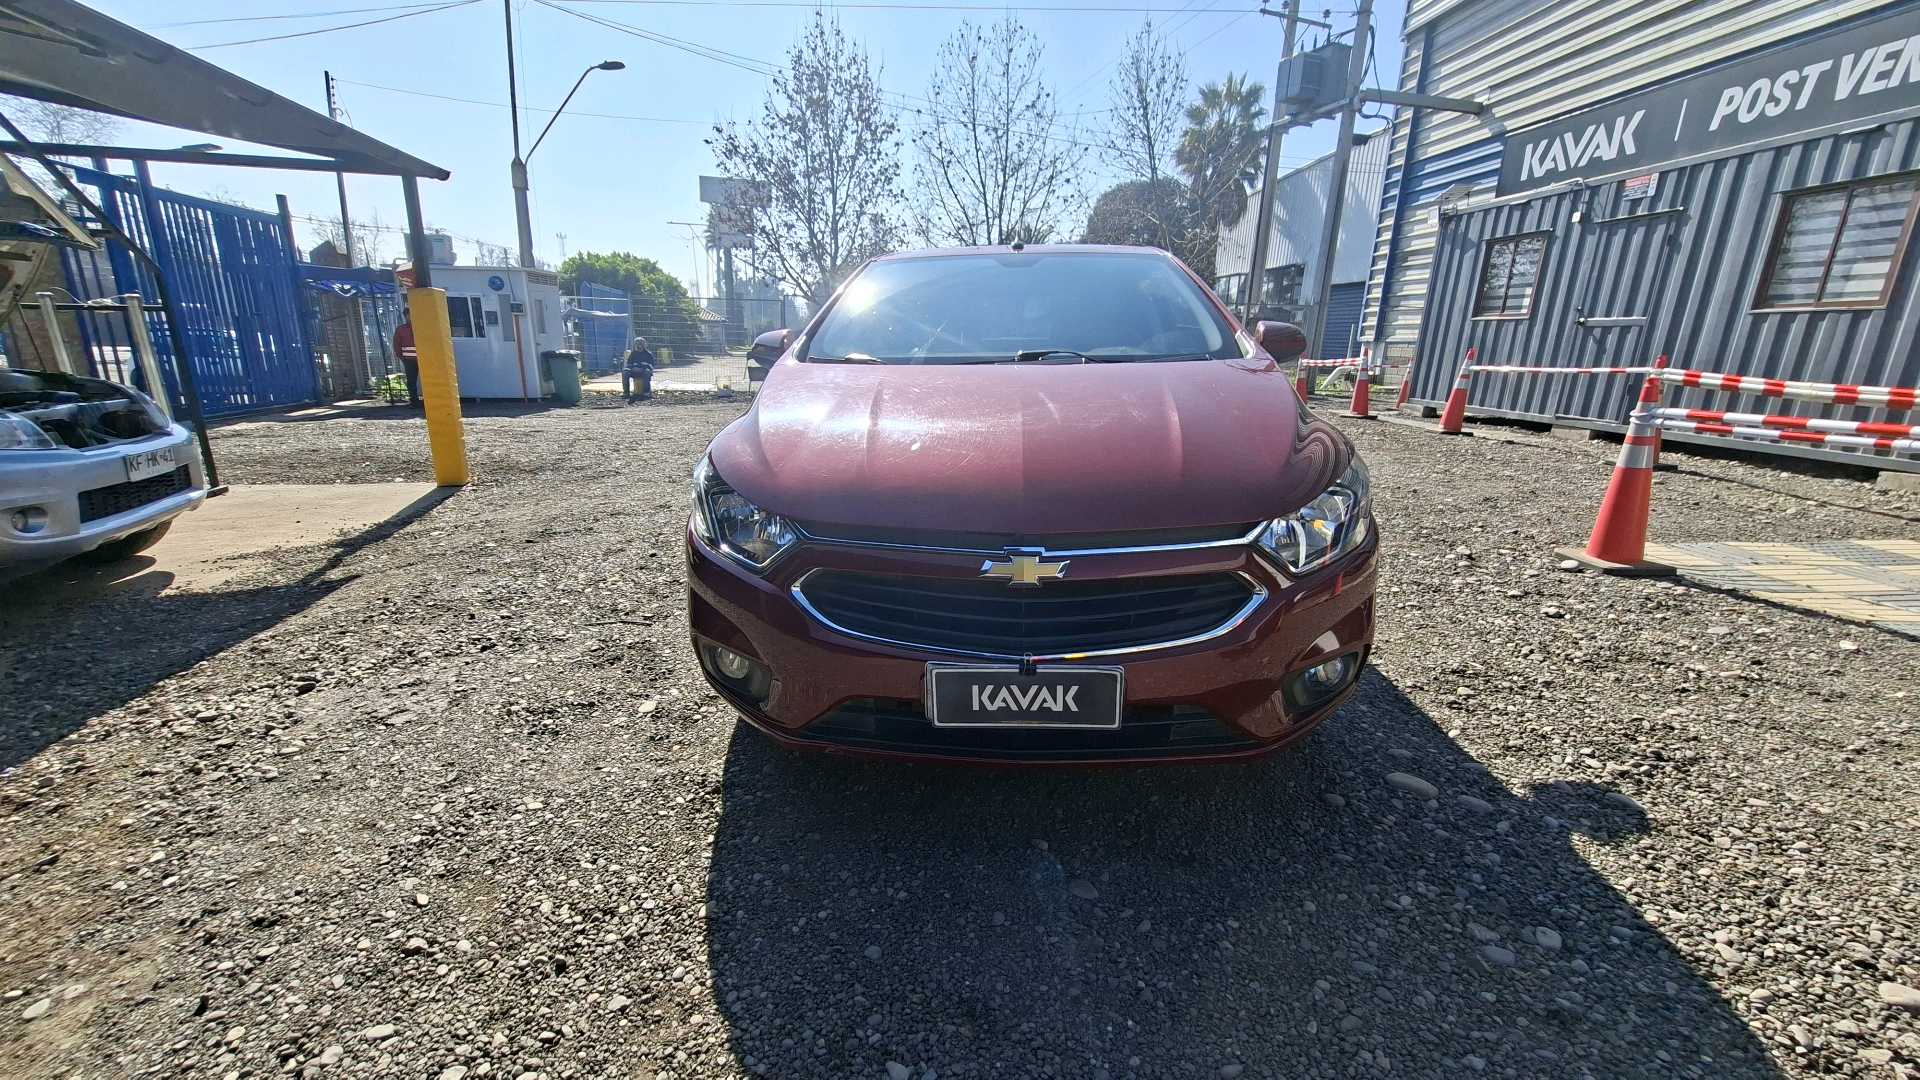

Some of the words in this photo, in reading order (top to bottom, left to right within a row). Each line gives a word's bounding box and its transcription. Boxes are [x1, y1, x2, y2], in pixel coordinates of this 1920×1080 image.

[1520, 109, 1646, 181] KAVAK
[1708, 59, 1834, 131] POST
[971, 684, 1080, 712] KAVAK
